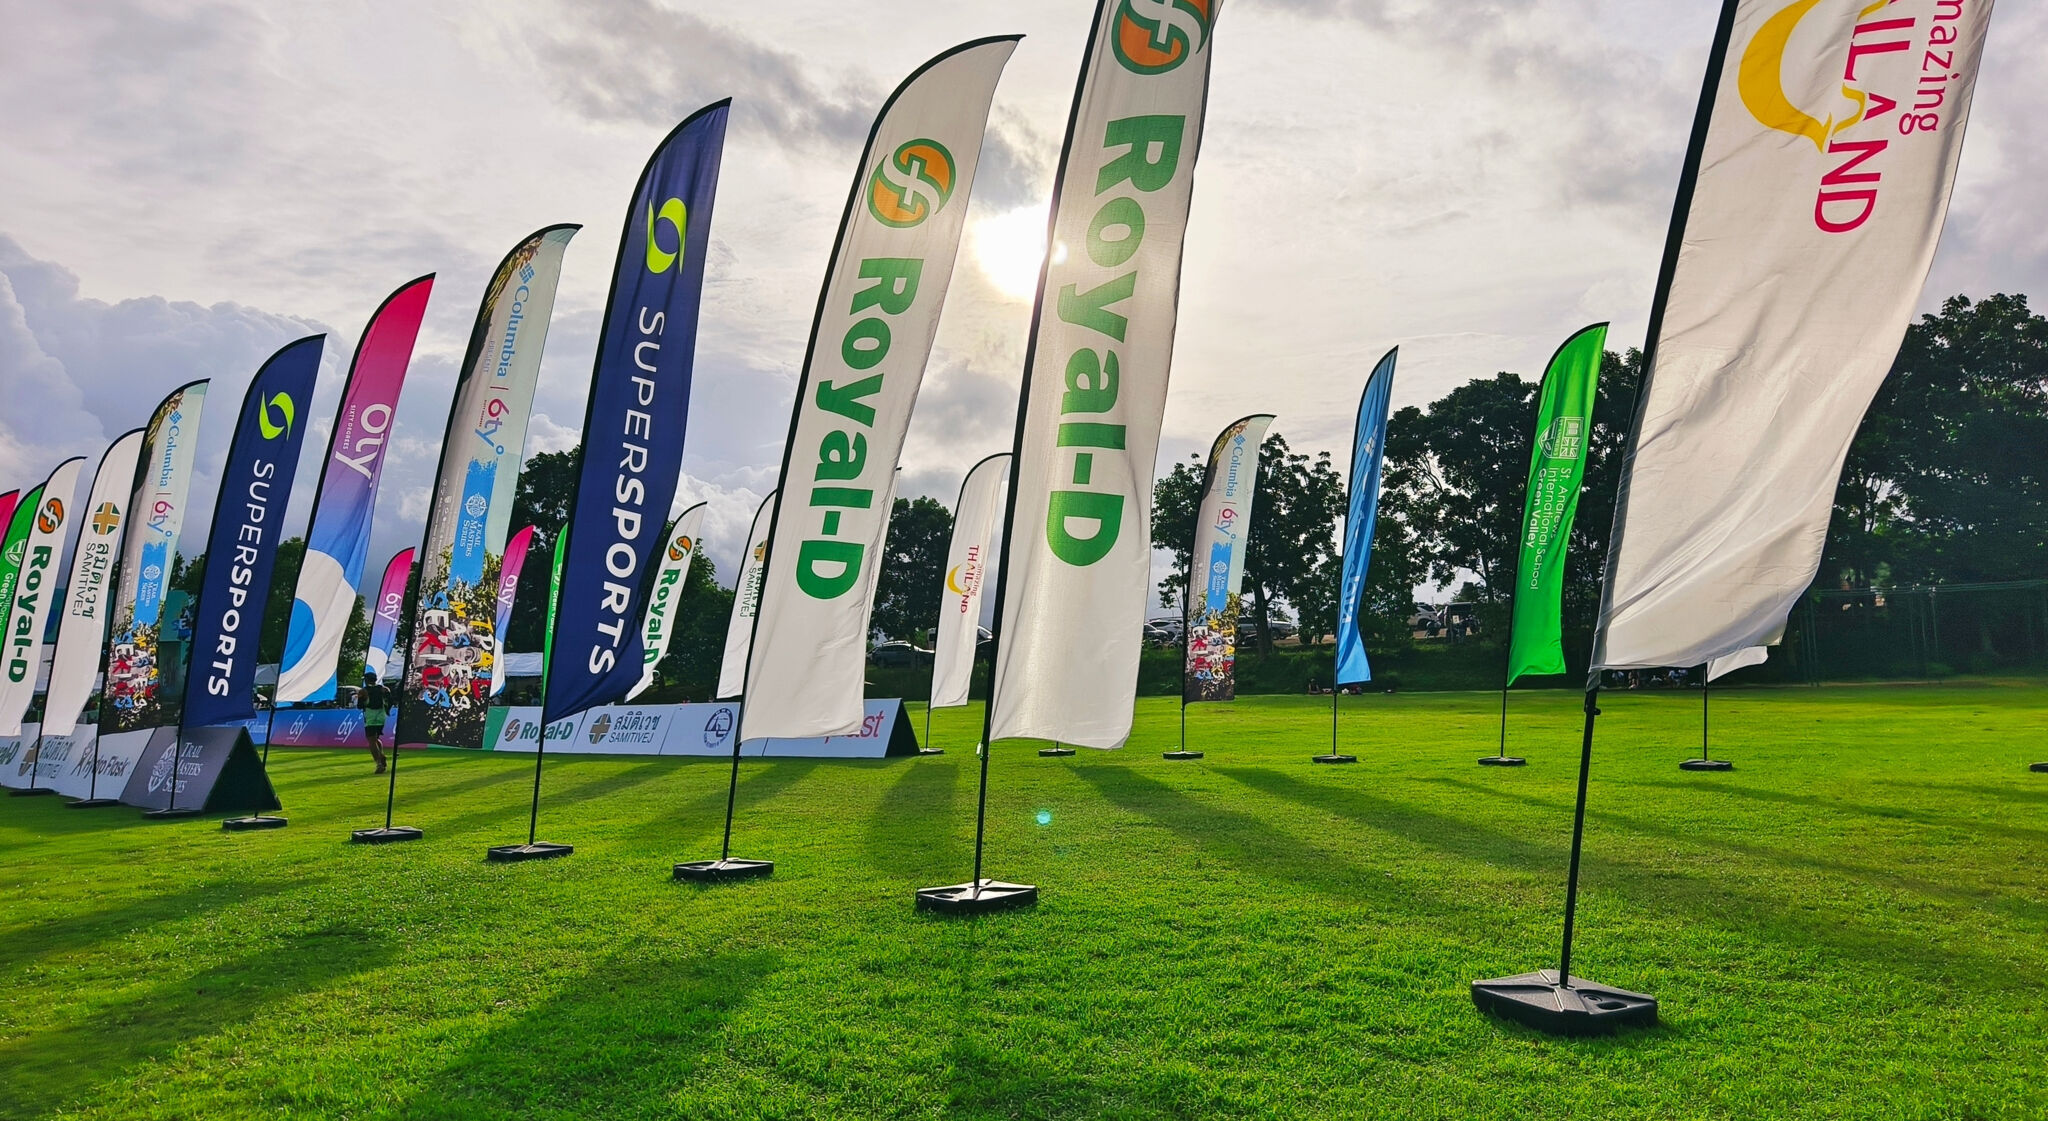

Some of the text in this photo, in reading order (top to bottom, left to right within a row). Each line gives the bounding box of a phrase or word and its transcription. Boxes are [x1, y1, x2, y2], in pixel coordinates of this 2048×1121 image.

[1899, 0, 1963, 135] mazing
[1814, 0, 1916, 233] ILAND
[497, 285, 530, 377] Columbia
[1046, 114, 1187, 566] Royal-D
[159, 425, 180, 487] Columbia
[795, 257, 924, 600] Royal-D
[588, 305, 666, 676] SUPERSPORTS
[1225, 446, 1244, 497] Columbia
[1525, 468, 1547, 549] Green Valley
[1550, 467, 1572, 539] St. Andrews
[459, 519, 471, 548] SERIES
[464, 519, 478, 557] MASTERS
[473, 521, 484, 548] TRAIL
[1530, 467, 1560, 590] International School
[7, 545, 53, 683] Royal-D
[72, 542, 96, 617] SAMITIVEJ
[207, 459, 274, 697] SUPERSPORTS
[643, 568, 681, 664] Royal-D
[739, 566, 757, 618] SAMITIVEJ
[960, 544, 980, 614] THAILAND
[608, 732, 655, 744] SAMITIVEJ
[613, 711, 662, 731] สมิติเวช
